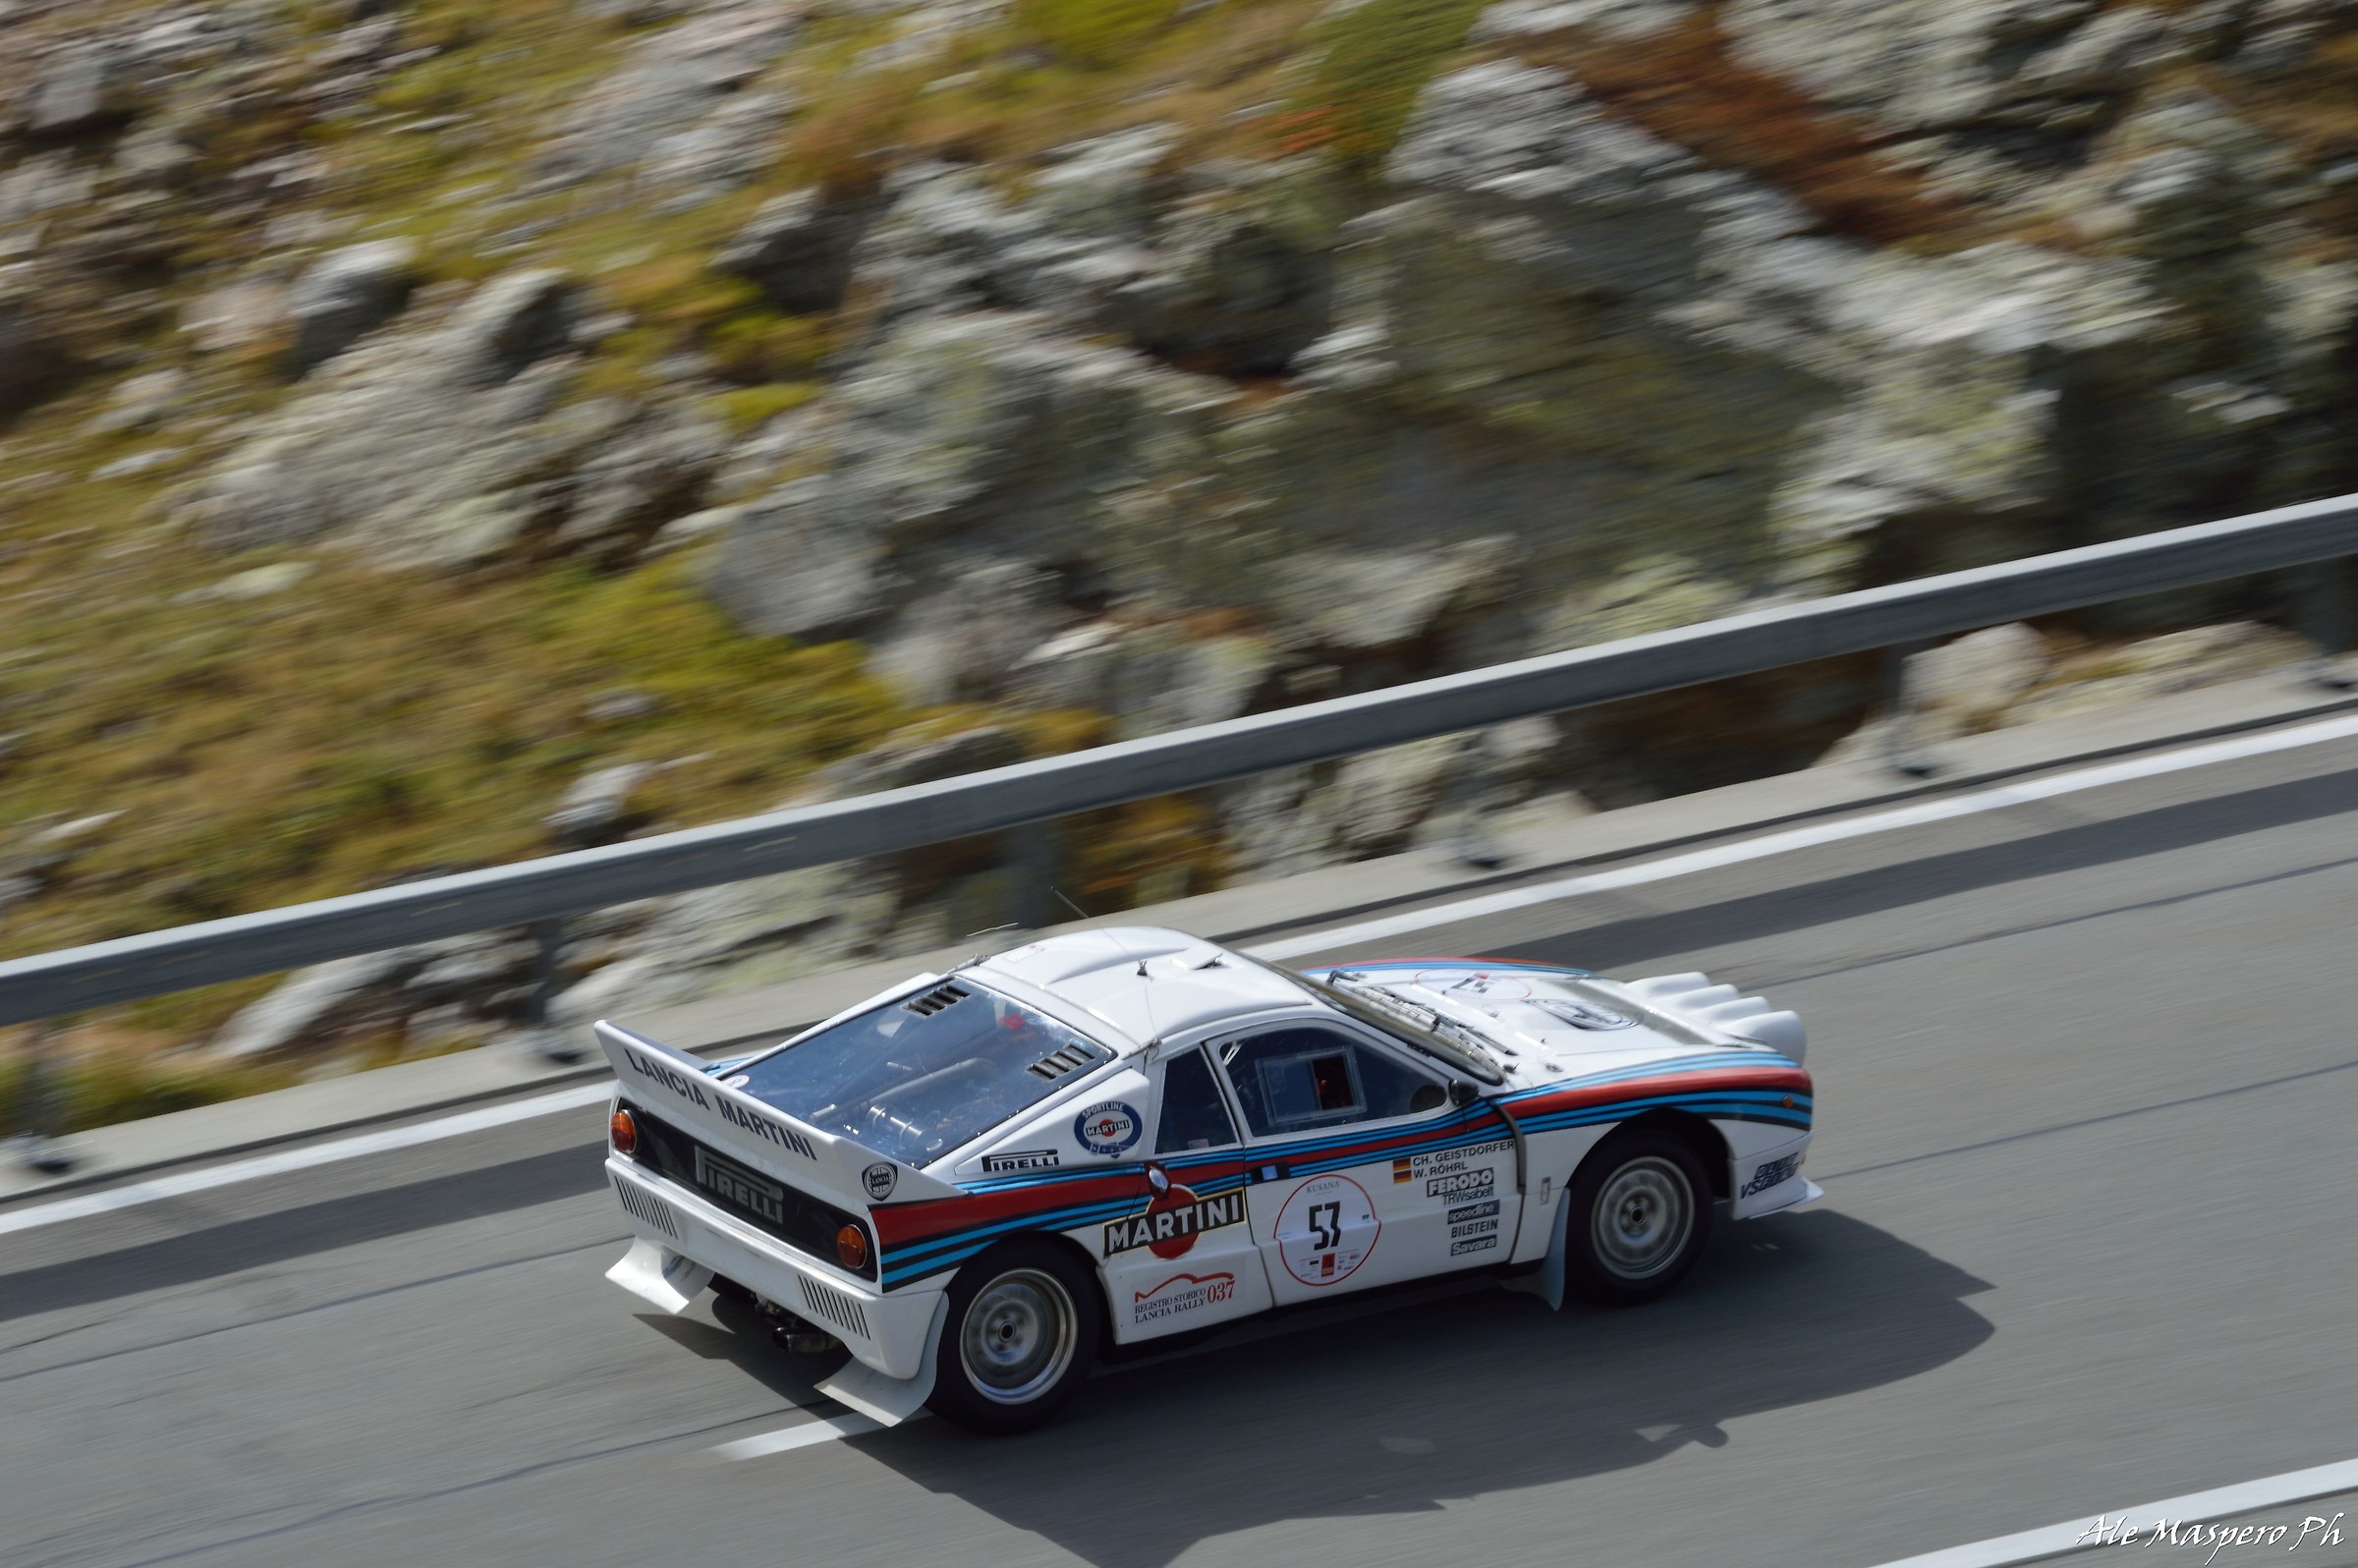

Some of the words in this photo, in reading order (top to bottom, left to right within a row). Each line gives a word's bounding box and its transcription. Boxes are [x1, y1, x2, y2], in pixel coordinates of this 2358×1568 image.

[625, 1048, 710, 1110] LANCIA
[715, 1094, 817, 1160] MARTINI
[1082, 1101, 1124, 1118] SPORTLINE
[1087, 1120, 1129, 1136] MARTINI
[982, 1148, 1059, 1172] PIRELLI
[1413, 1155, 1432, 1166] CH.
[1434, 1140, 1515, 1162] GEISTDORFER
[1414, 1169, 1428, 1179] W.
[1430, 1161, 1468, 1176] RÖHRL
[1428, 1169, 1492, 1196] FERODO
[695, 1144, 784, 1224] PIRELLI
[1307, 1181, 1340, 1193] KUSANA
[1108, 1195, 1240, 1255] MARTINI
[1449, 1204, 1493, 1222] speedline
[1309, 1201, 1341, 1251] 57
[1451, 1219, 1498, 1238] BILSTEIN
[1452, 1238, 1494, 1255] Savara
[1135, 1297, 1172, 1314] REGISTRO
[1173, 1288, 1206, 1304] STORICO
[1207, 1279, 1235, 1304] 037
[1135, 1309, 1171, 1323] LANCIA
[1174, 1297, 1206, 1313] RALLY
